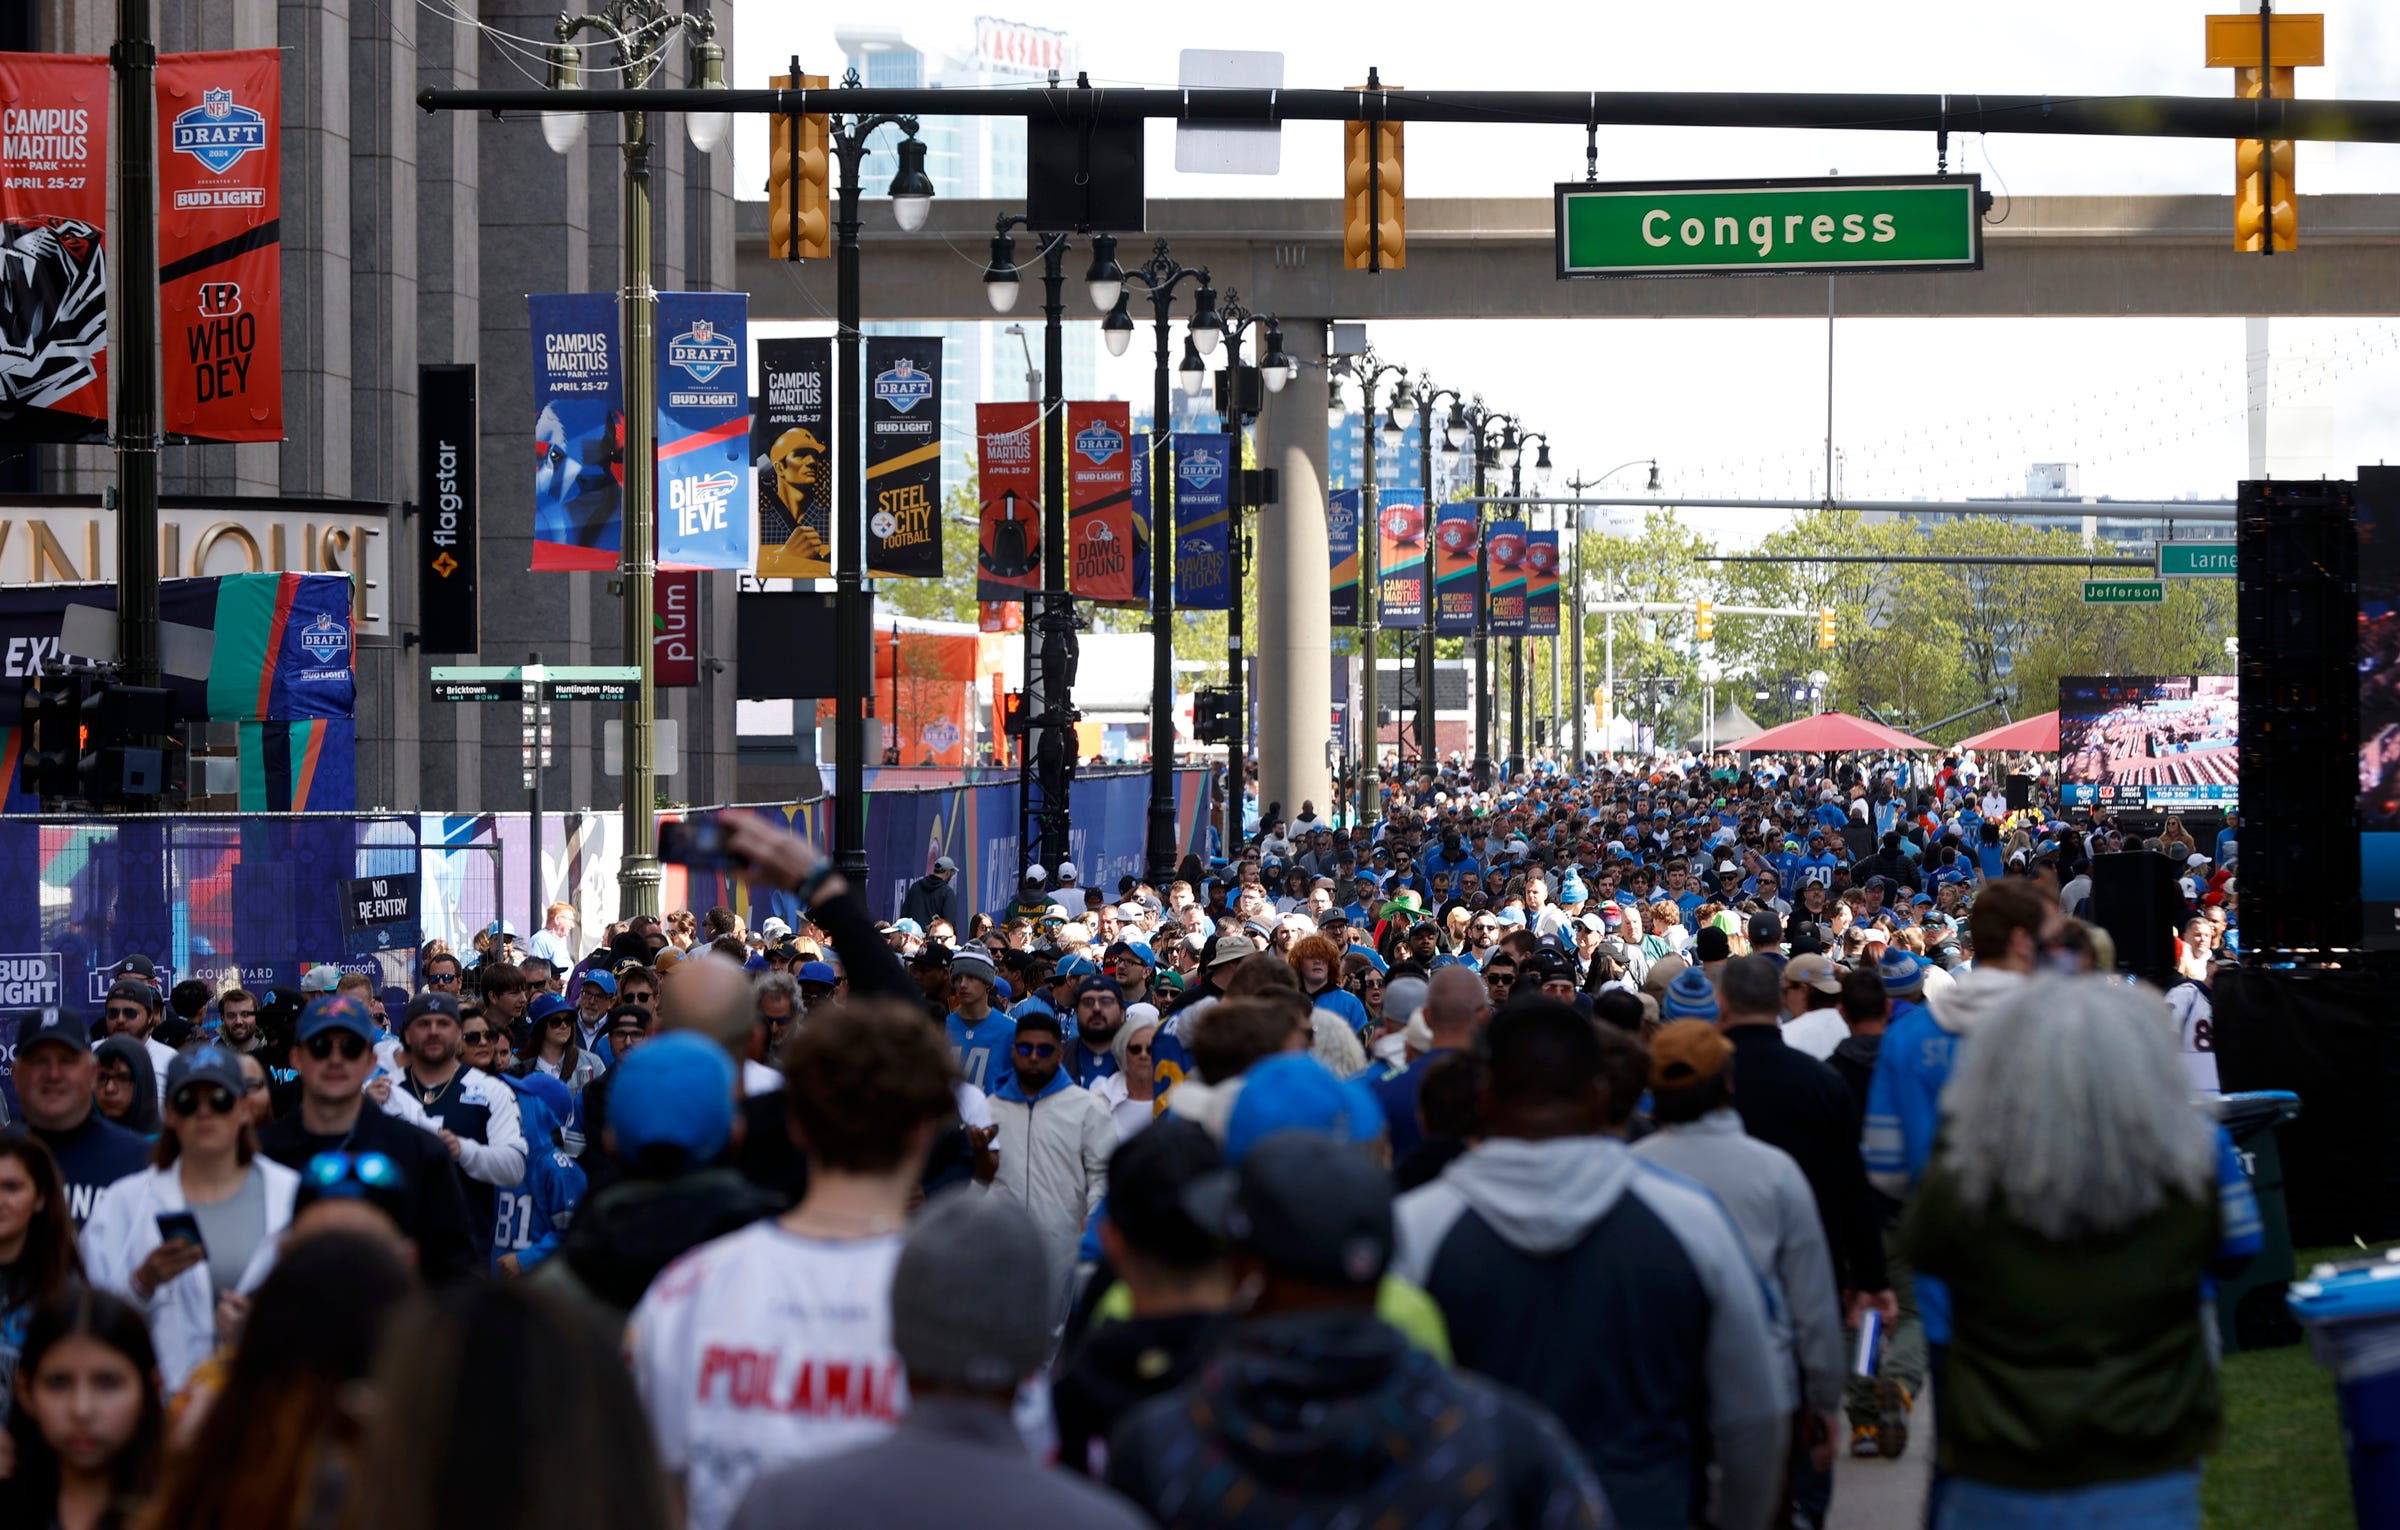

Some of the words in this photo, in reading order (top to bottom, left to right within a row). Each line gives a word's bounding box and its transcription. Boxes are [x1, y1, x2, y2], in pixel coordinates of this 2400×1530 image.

[207, 101, 229, 116] NFL
[3, 108, 88, 134] CAMPUS
[180, 127, 257, 144] DRAFT
[3, 135, 87, 160] MARTIUS
[29, 161, 58, 170] PARK
[4, 177, 44, 188] APRIL
[47, 177, 86, 188] 25-27
[177, 192, 211, 206] BUD
[213, 191, 263, 204] LIGHT
[1641, 208, 1897, 257] Congress
[186, 312, 255, 364] WHO
[545, 333, 607, 352] CAMPUS
[695, 329, 711, 340] NFL
[546, 352, 608, 371] MARTIUS
[675, 348, 731, 361] DRAFT
[196, 353, 252, 404] DEY
[550, 382, 580, 392] APRIL
[581, 381, 609, 391] 25-27
[768, 372, 821, 389] CAMPUS
[879, 383, 928, 394] DRAFT
[672, 395, 699, 405] BUD
[699, 395, 735, 405] LIGHT
[769, 389, 821, 405] MARTIUS
[770, 415, 796, 423] APRIL
[797, 414, 821, 422] 25-27
[877, 424, 899, 432] BUD
[900, 423, 930, 432] LIGHT
[986, 432, 1031, 446] CAMPUS
[1080, 440, 1119, 448] DRAFT
[987, 446, 1031, 460] MARTIUS
[433, 440, 462, 547] flagstar
[878, 484, 930, 512] STEEL
[679, 499, 728, 537] IEVE
[894, 506, 931, 534] CITY
[883, 530, 932, 550] FOOTBALL
[1078, 537, 1121, 562] DAWG
[1076, 555, 1126, 580] POUND
[1177, 551, 1225, 576] RAVENS
[2190, 553, 2238, 568] Larne
[1182, 570, 1222, 592] FLOCK
[1383, 579, 1420, 591] CAMPUS
[1384, 590, 1421, 602] MARTIUS
[2088, 586, 2160, 598] Jefferson
[1442, 604, 1453, 612] THE
[1454, 604, 1472, 612] CLOCK
[1493, 597, 1524, 607] CAMPUS
[1493, 606, 1524, 616] MARTIUS
[654, 585, 694, 661] plum
[306, 636, 343, 645] DRAFT
[446, 685, 486, 694] Bricktown
[556, 685, 600, 695] Huntington
[602, 685, 625, 694] Place
[372, 880, 388, 897] NO
[359, 898, 408, 925] RE-ENTRY
[0, 960, 46, 982] BUD
[0, 982, 57, 1004] IGHT
[495, 1192, 533, 1250] 81
